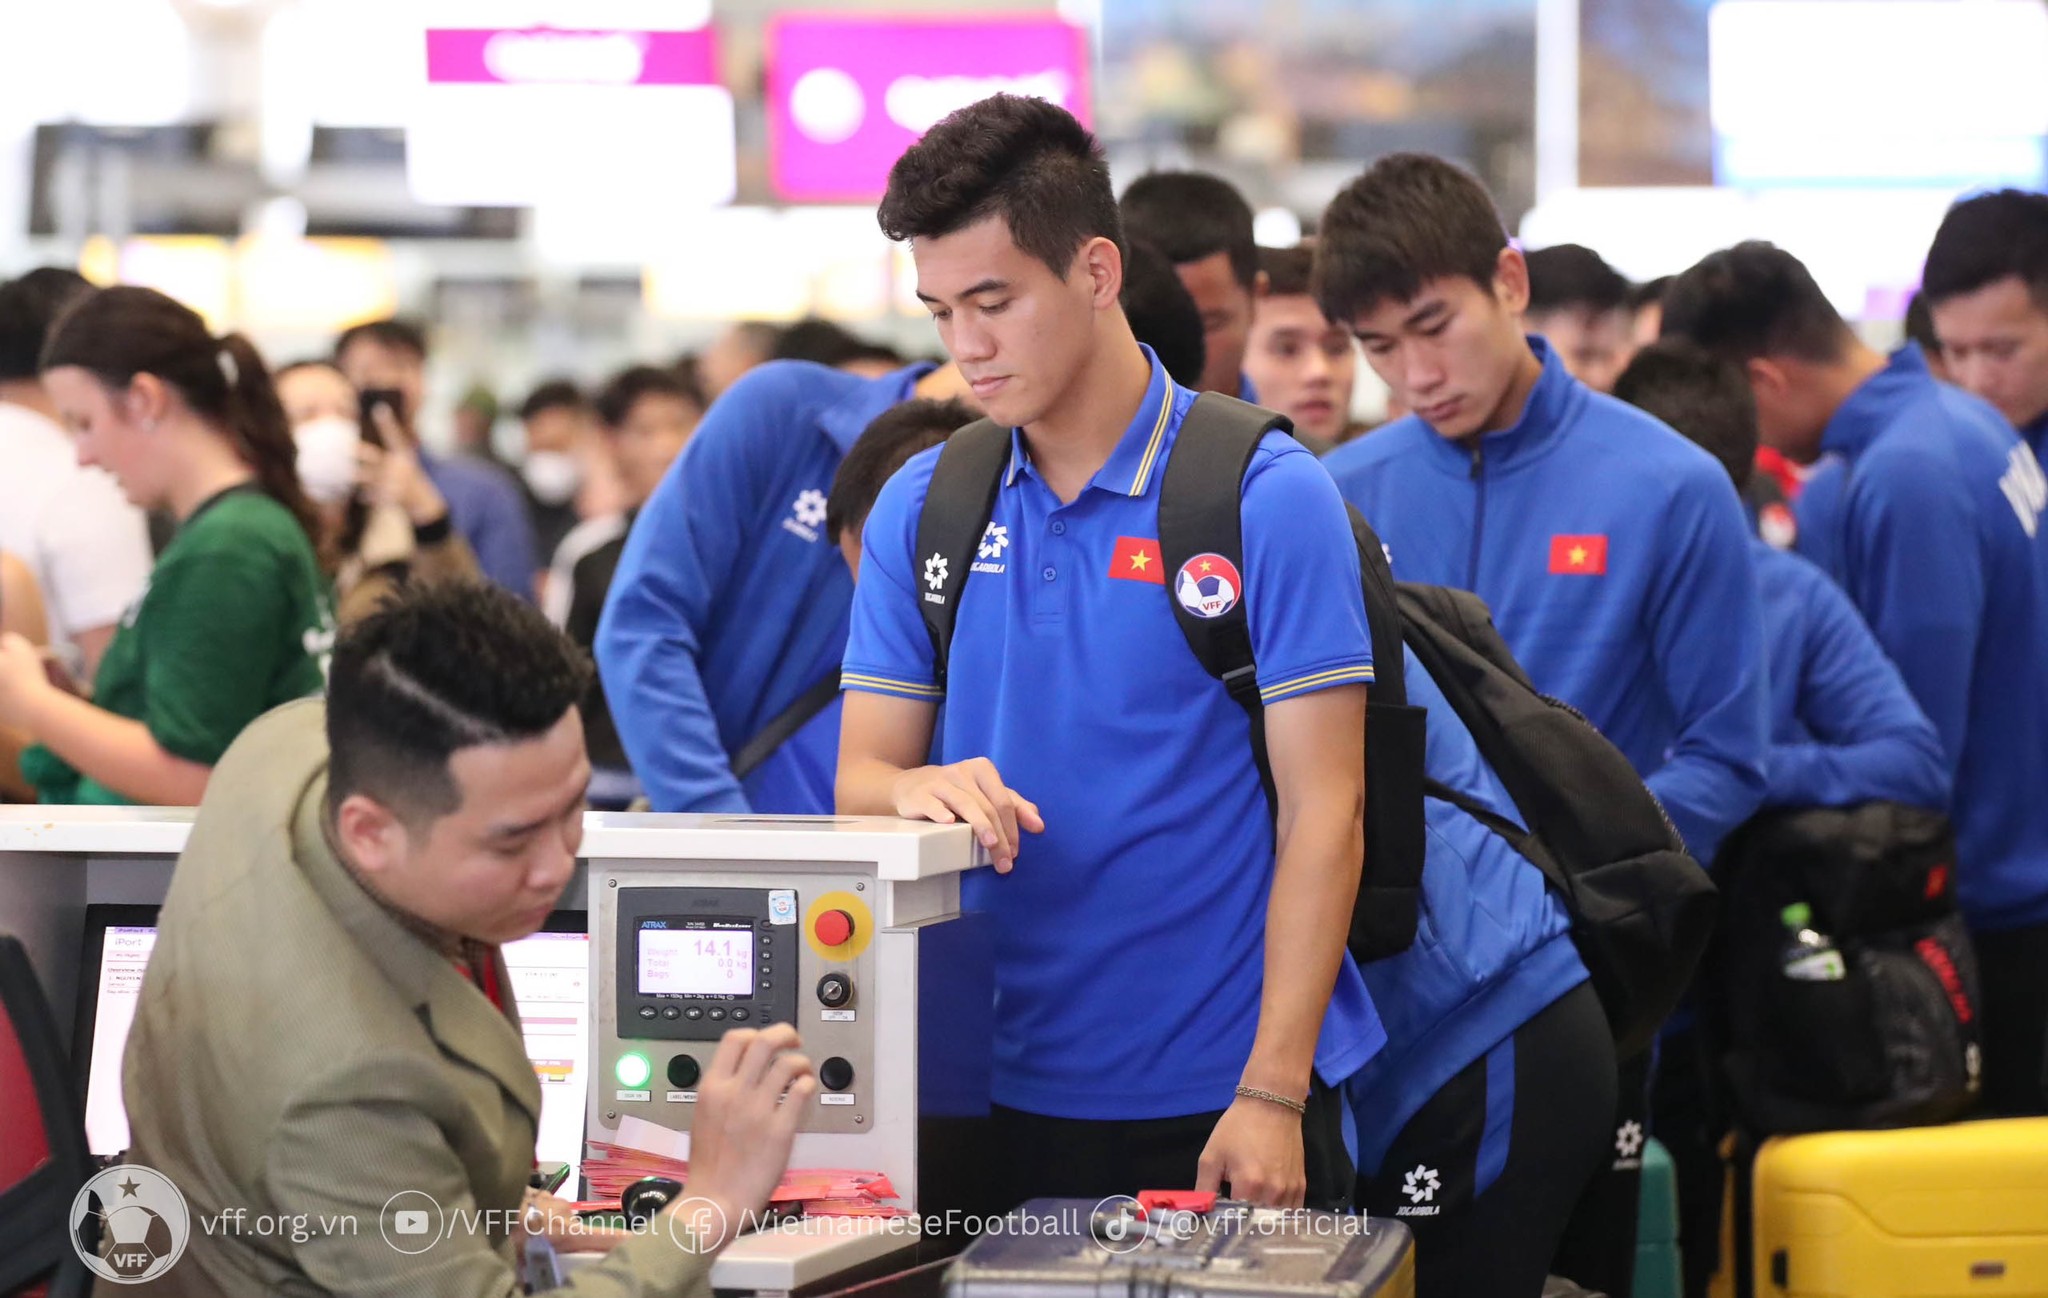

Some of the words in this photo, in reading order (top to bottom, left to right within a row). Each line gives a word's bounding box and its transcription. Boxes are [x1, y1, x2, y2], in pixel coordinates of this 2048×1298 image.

[1202, 600, 1222, 611] VFF
[641, 921, 667, 929] ATRAX
[115, 938, 142, 946] iPort
[693, 939, 731, 956] 14.1
[736, 949, 747, 959] kg
[647, 958, 669, 967] Total
[736, 960, 747, 969] kg
[647, 969, 669, 979] Bags
[726, 969, 733, 978] 0
